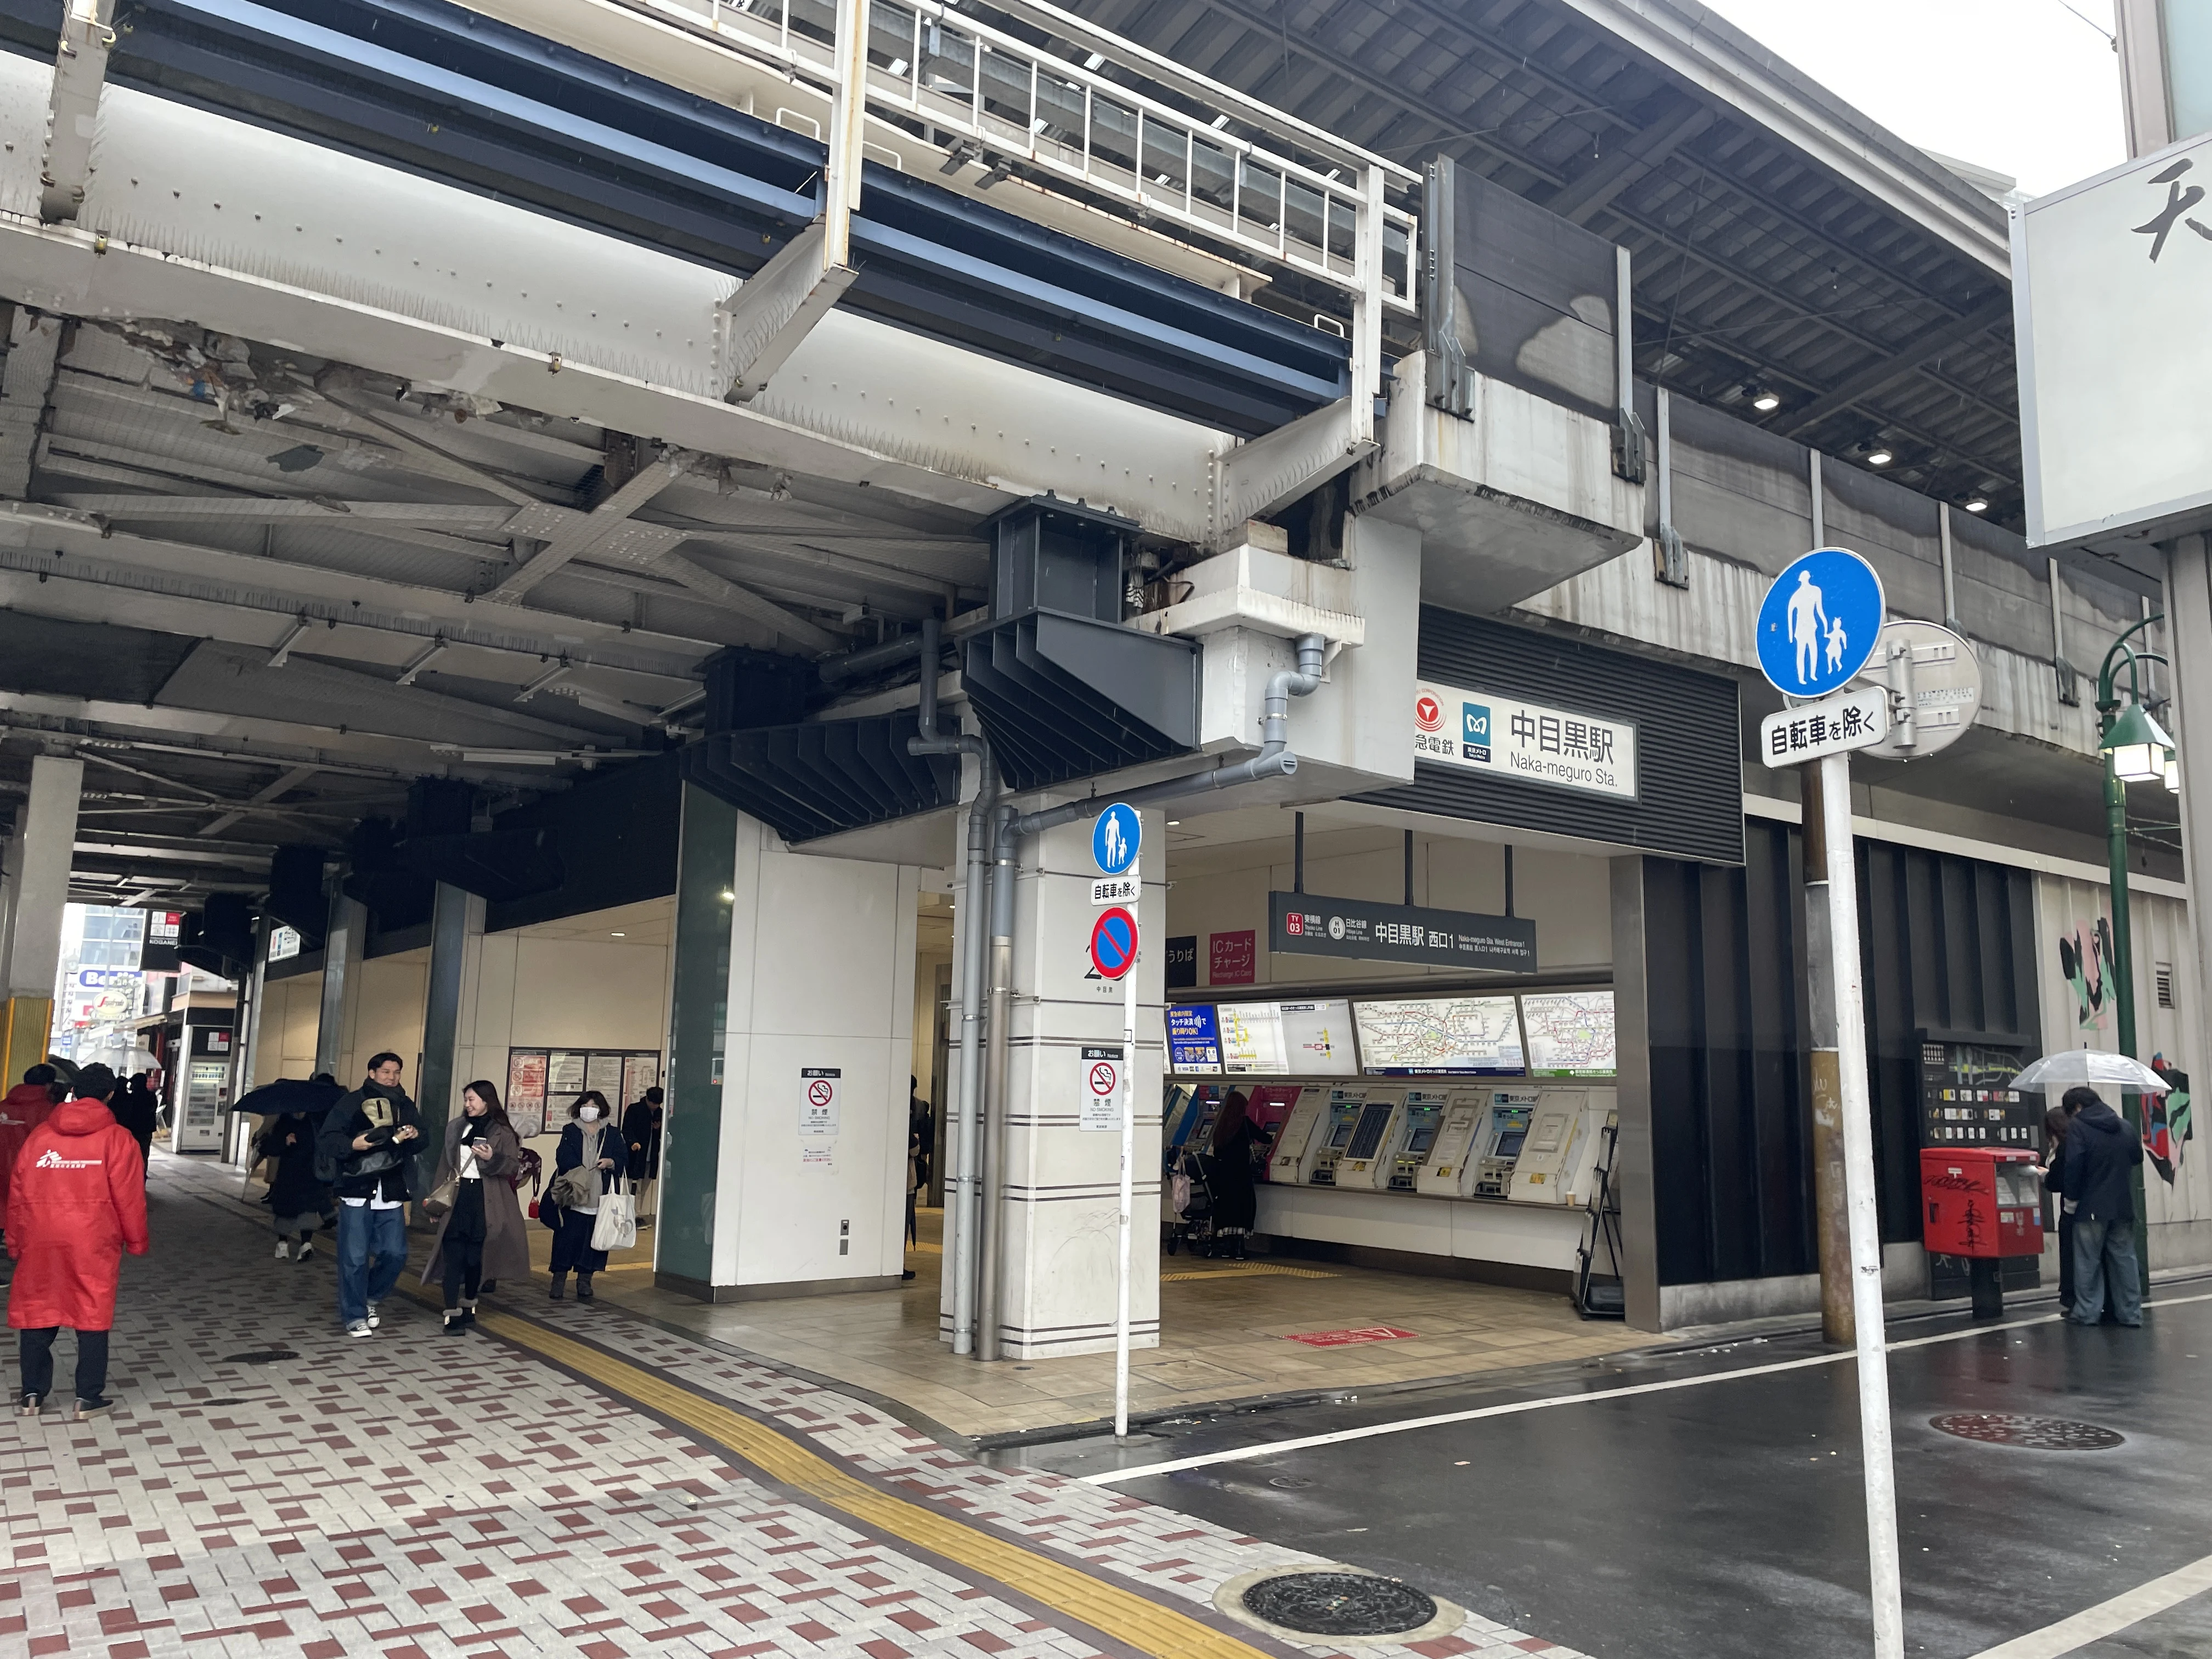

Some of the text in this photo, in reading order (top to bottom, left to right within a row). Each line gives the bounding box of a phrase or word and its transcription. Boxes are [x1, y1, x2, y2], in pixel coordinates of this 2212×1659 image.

[1511, 709, 1614, 765] 中目黒駅
[1771, 705, 1875, 756] 自転車を除く
[1510, 751, 1617, 787] Naka-meguro Sta.
[1094, 882, 1136, 899] 自転車を除く
[1305, 915, 1321, 924] 東横線
[1346, 918, 1367, 929] 日比谷線
[1290, 923, 1300, 933] 03
[1375, 922, 1424, 946] 中目黒駅
[1213, 938, 1252, 953] ICカード
[1458, 934, 1486, 945] Naka-meguro
[1166, 947, 1194, 963] うりば
[1214, 953, 1250, 969] チャージ
[1087, 1049, 1106, 1058] お願い
[1093, 1098, 1111, 1107] 禁煙
